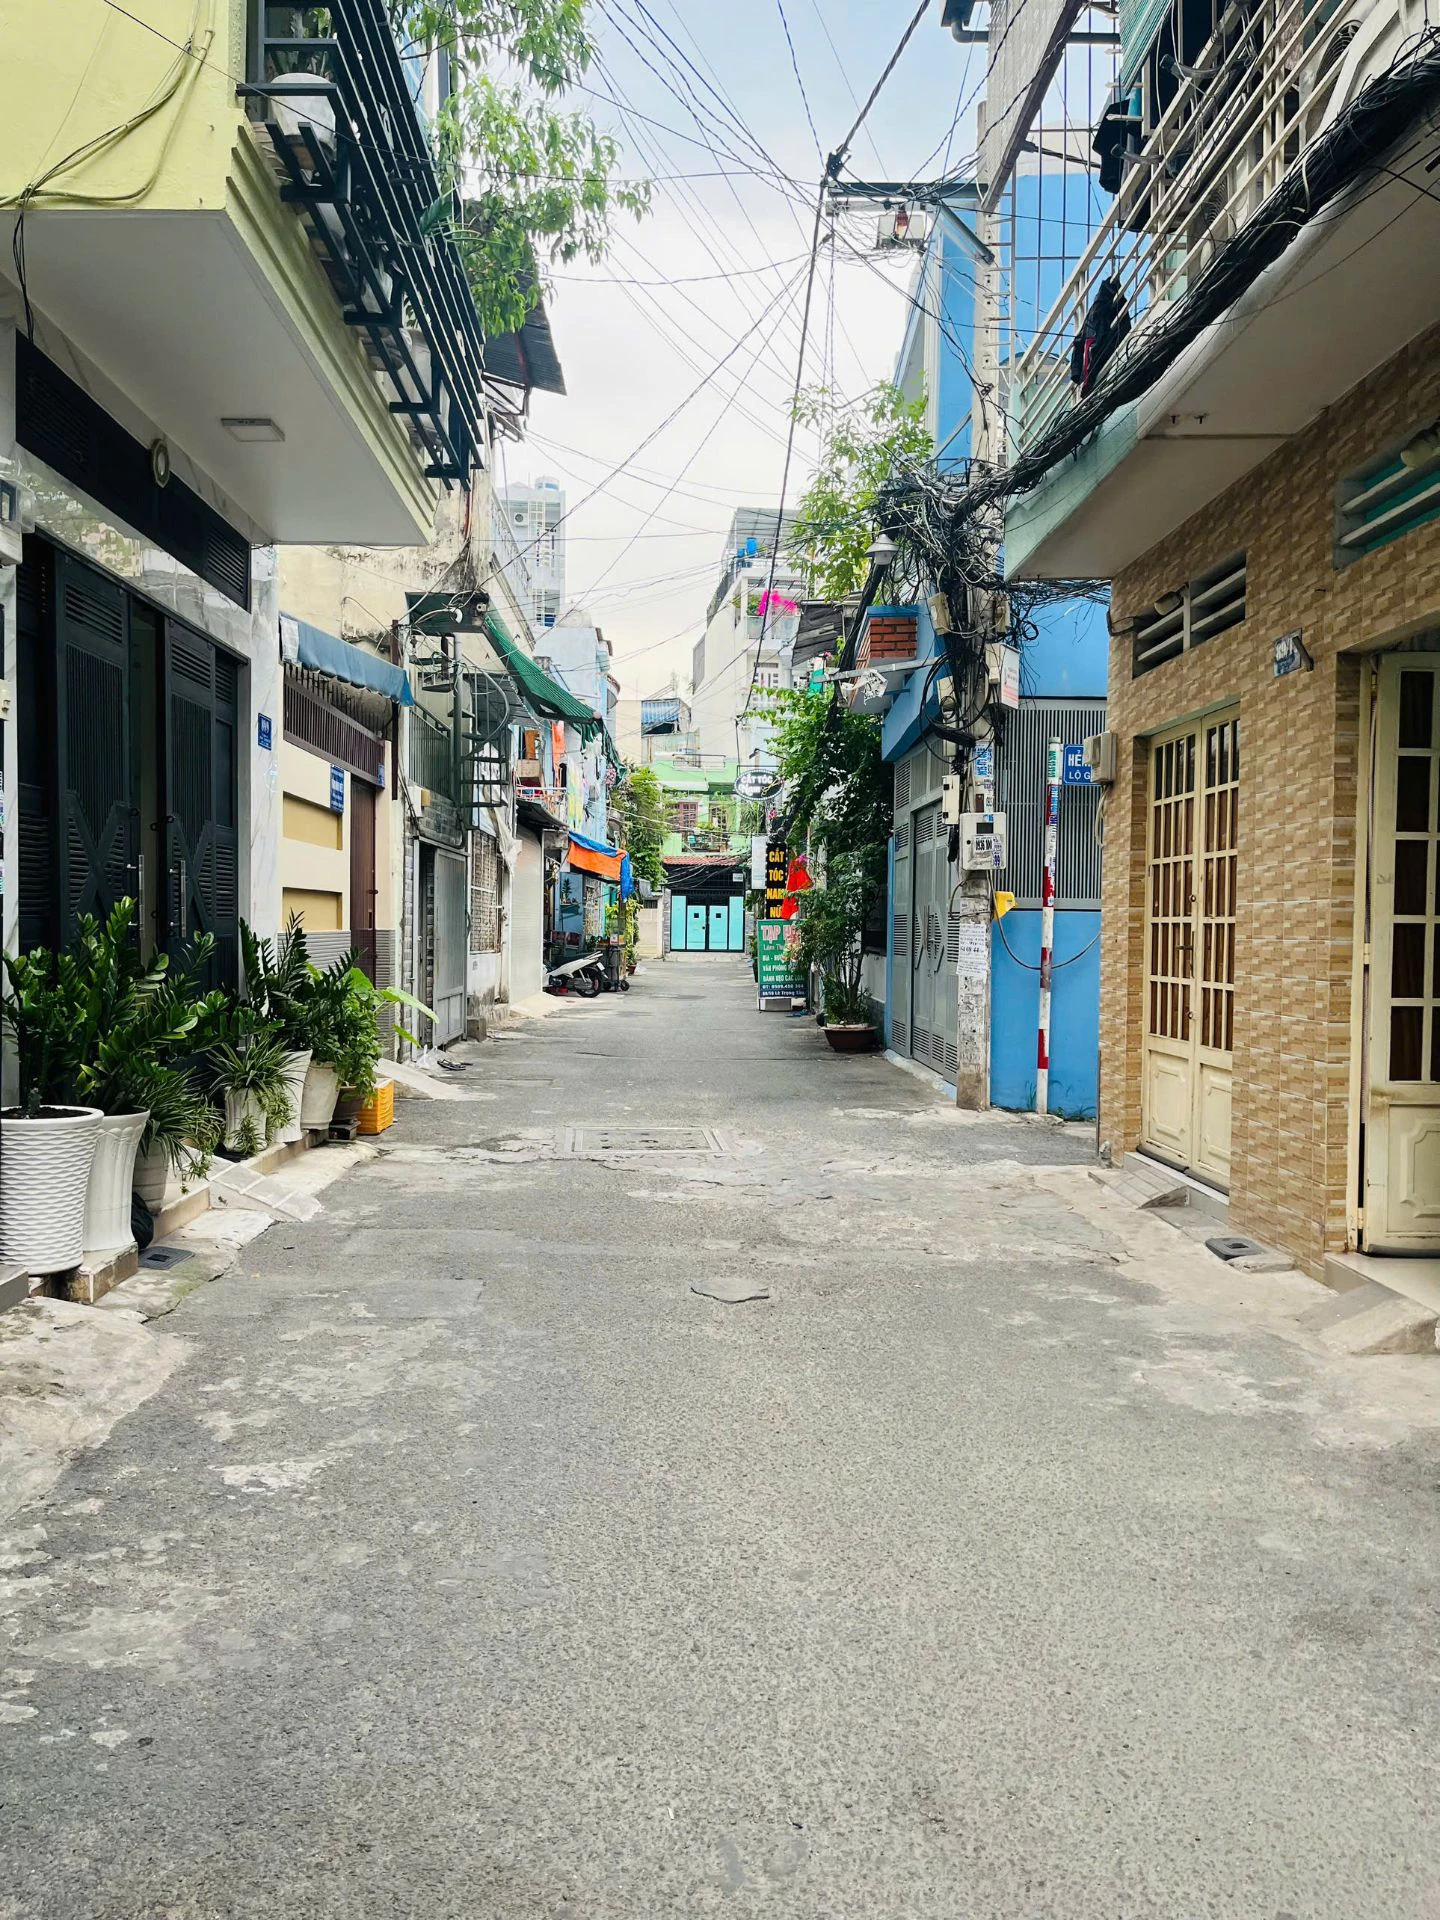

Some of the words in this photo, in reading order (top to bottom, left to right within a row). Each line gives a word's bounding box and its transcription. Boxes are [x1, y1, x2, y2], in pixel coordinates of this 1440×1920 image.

[1068, 750, 1091, 767] HẺ
[741, 774, 756, 784] CẮT
[758, 774, 773, 784] TÓC
[1069, 770, 1082, 781] LỘ
[768, 847, 785, 863] CẮT
[768, 867, 784, 882] TÓC
[760, 925, 781, 945] TẠP
